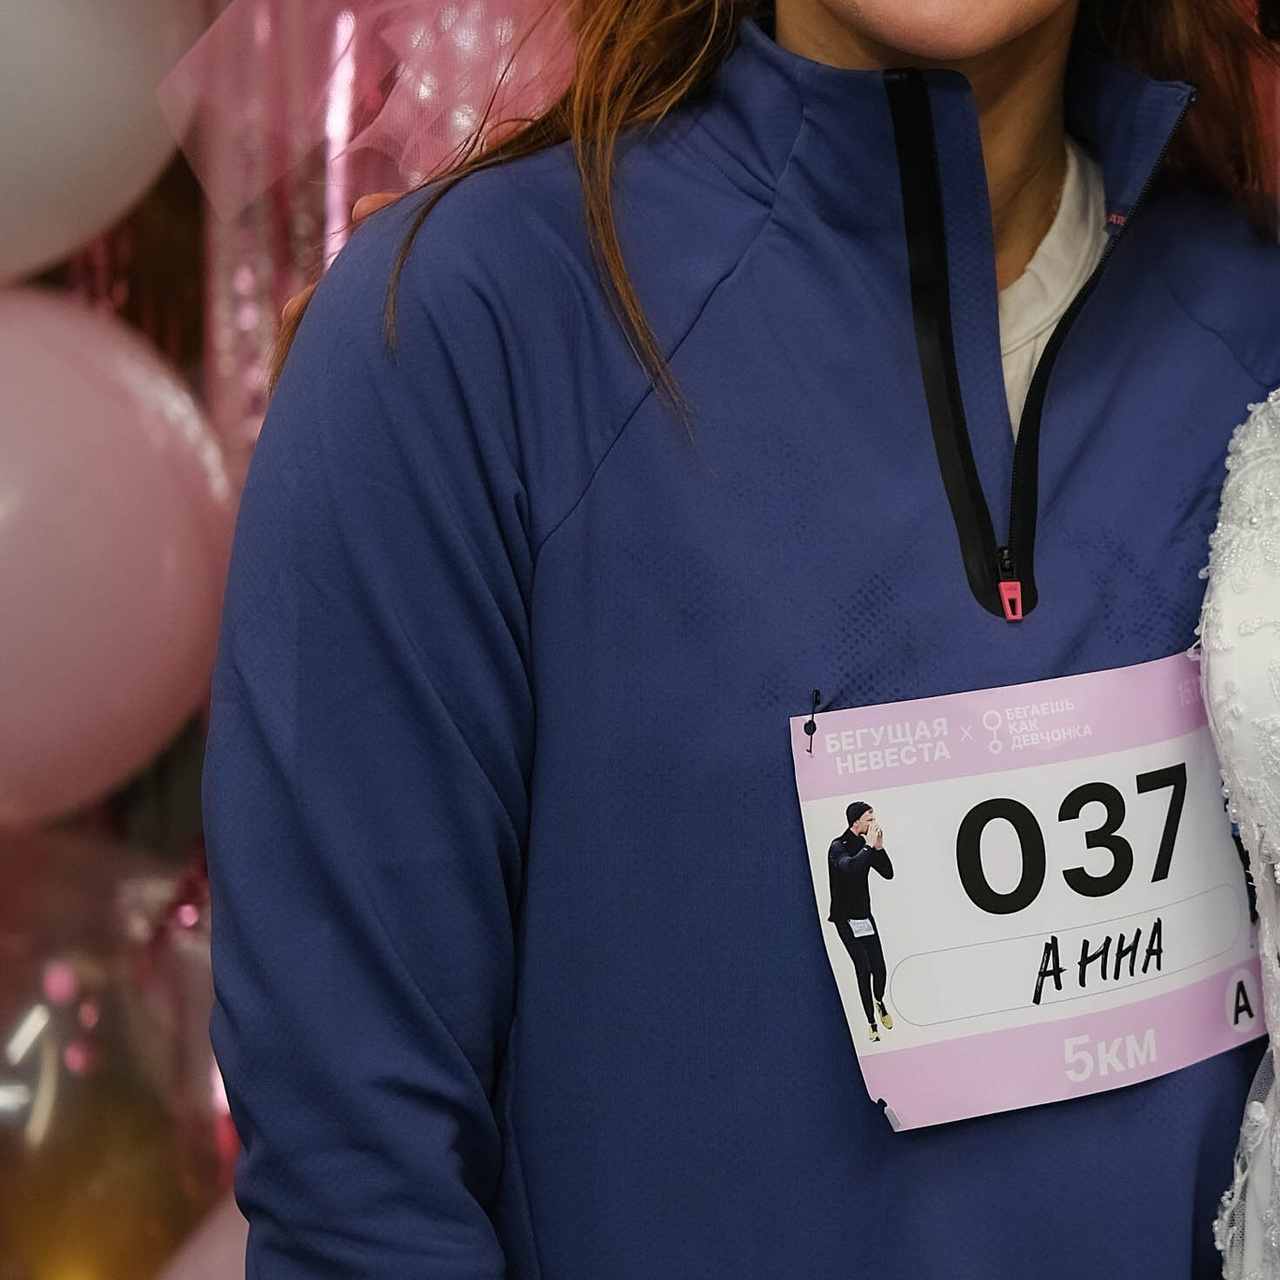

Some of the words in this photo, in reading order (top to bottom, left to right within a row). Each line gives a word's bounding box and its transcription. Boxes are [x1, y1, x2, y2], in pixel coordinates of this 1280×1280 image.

[1005, 699, 1075, 722] БЕГАЕШЬ
[1008, 718, 1038, 735] КАК
[824, 717, 948, 754] БЕГУЩАЯ
[1011, 723, 1093, 752] ДЕВЧОНКА
[836, 740, 951, 775] НЕВЕСТА
[956, 761, 1187, 915] 037
[1032, 916, 1164, 1006] АННА
